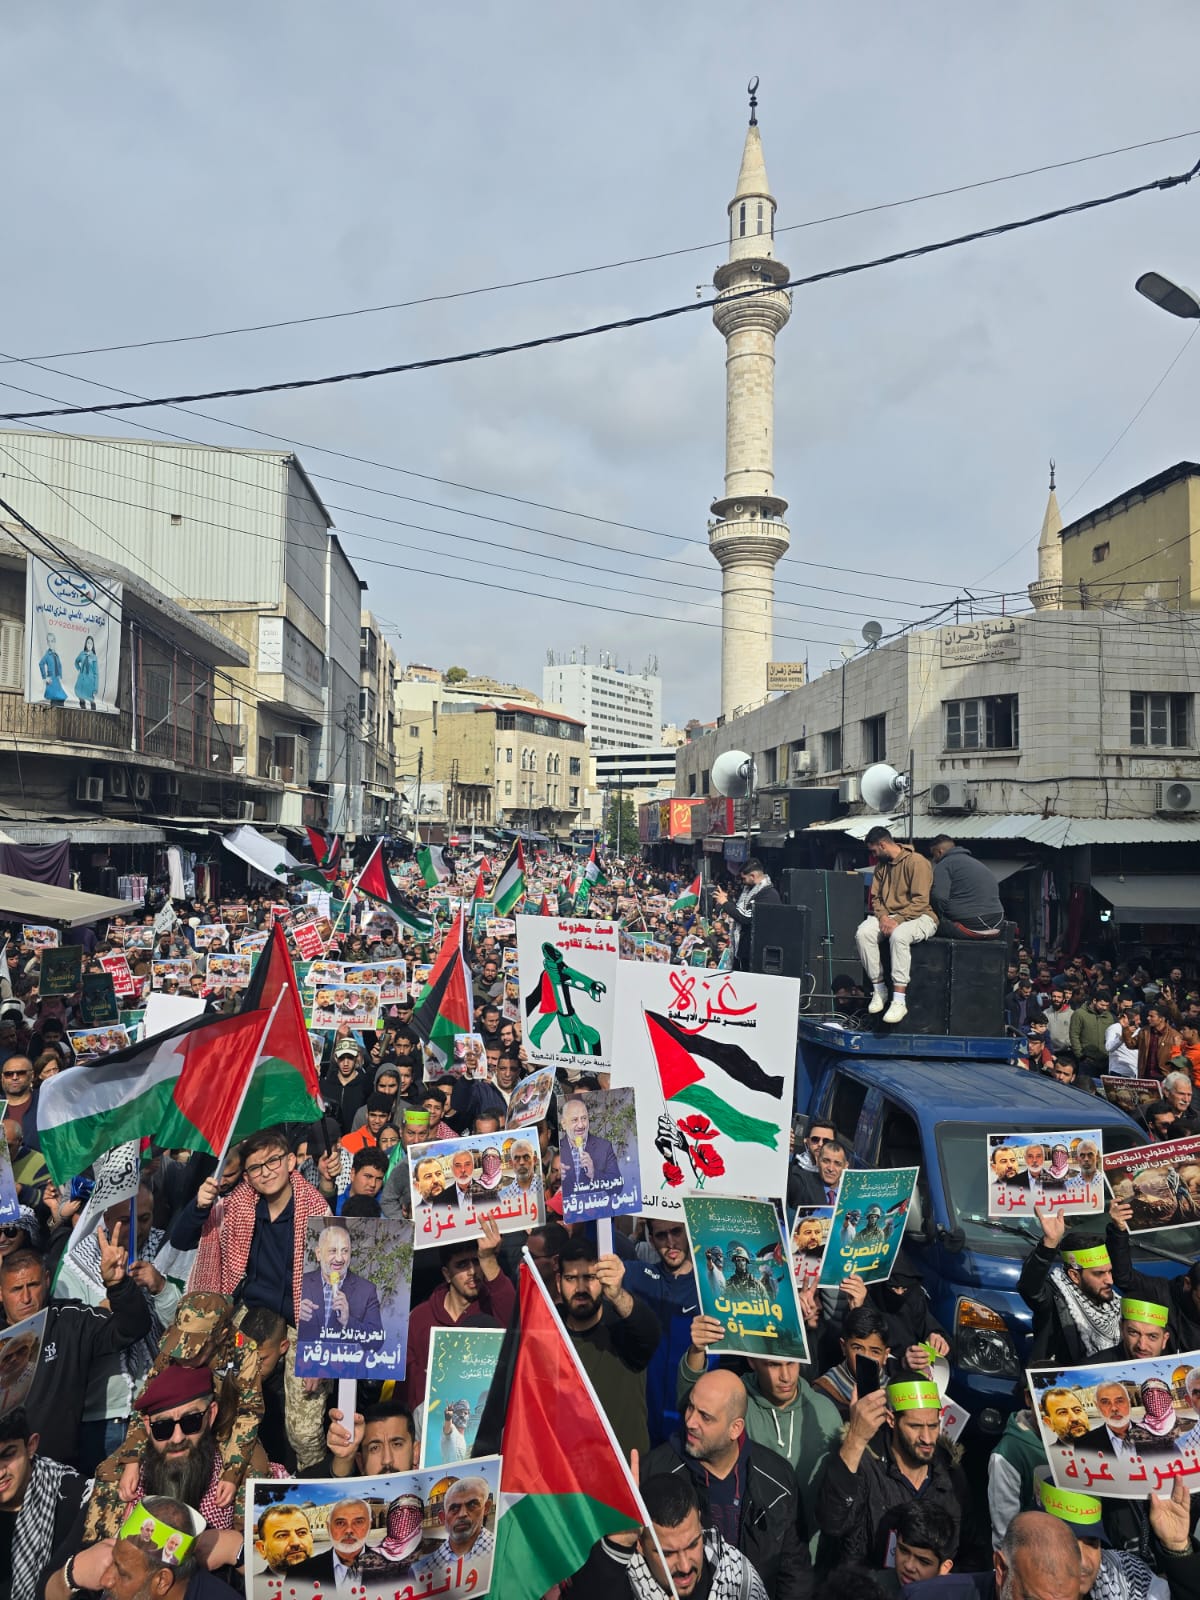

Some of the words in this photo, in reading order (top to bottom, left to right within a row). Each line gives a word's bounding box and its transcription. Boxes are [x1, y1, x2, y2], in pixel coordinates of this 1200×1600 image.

[944, 625, 980, 646] زهران
[983, 619, 1016, 640] فندق
[605, 942, 616, 952] ما
[1105, 1152, 1142, 1166] للمقاومة
[1142, 1145, 1176, 1161] البطولي
[1150, 1158, 1171, 1169] حرب
[573, 1179, 600, 1192] للأستاذ
[600, 1176, 625, 1190] الحرية
[562, 1193, 610, 1214] صندوقة
[612, 1185, 638, 1210] أيمن
[662, 1196, 682, 1208] حدة
[997, 1187, 1027, 1212] غزة
[1034, 1185, 1098, 1212] وانتصرت
[423, 1205, 456, 1239] غزة
[839, 1242, 890, 1258] وانتصرت
[843, 1257, 880, 1273] غزة
[714, 1296, 783, 1321] وانتصرت
[319, 1326, 354, 1341] للأستاذ
[354, 1328, 386, 1343] الحرية
[726, 1317, 779, 1338] غزة
[302, 1340, 365, 1368] صندوقة
[364, 1343, 402, 1371] أيمن
[1061, 1450, 1115, 1487] غزة
[1128, 1449, 1200, 1490] تصرت
